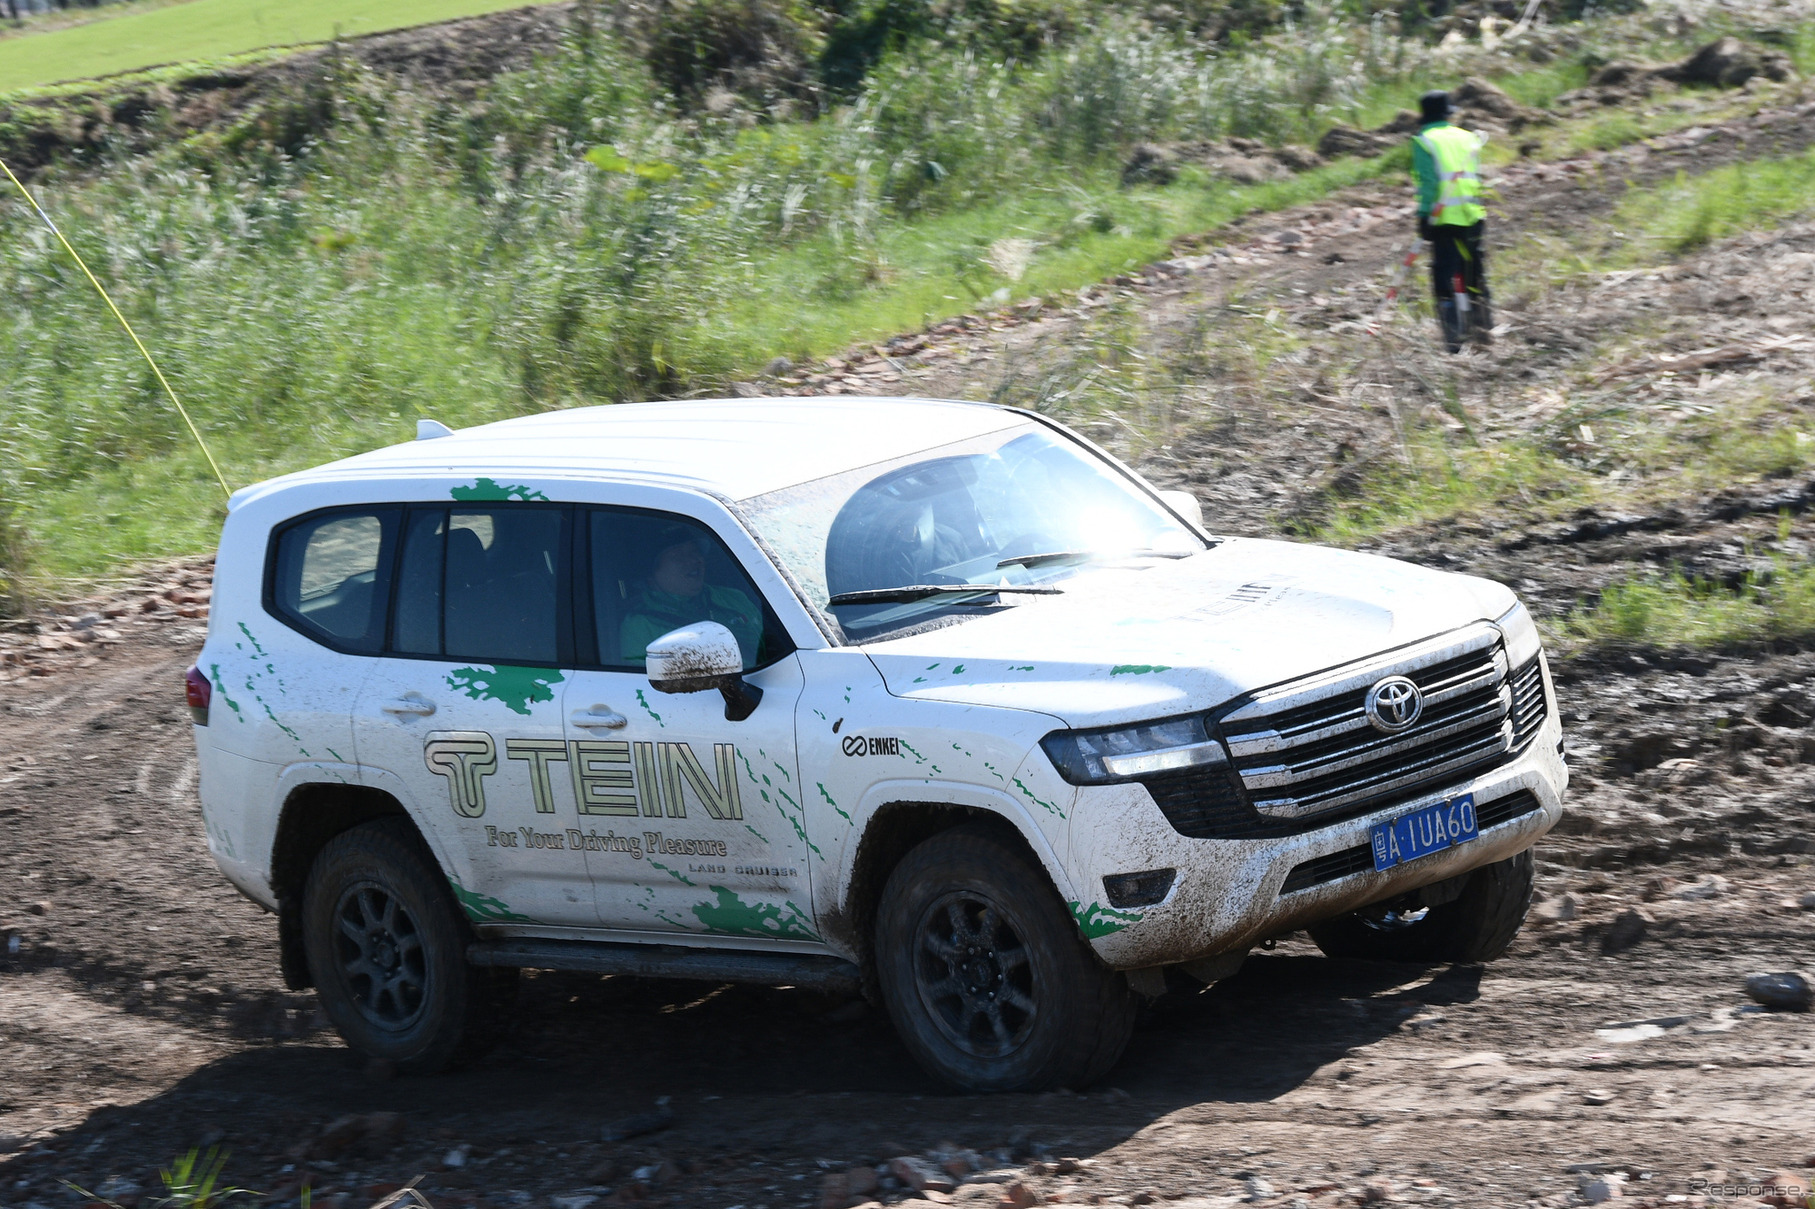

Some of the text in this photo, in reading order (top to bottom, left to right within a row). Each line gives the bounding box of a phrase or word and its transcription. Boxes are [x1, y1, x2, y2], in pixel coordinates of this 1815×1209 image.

[868, 737, 900, 756] ENKEI
[505, 738, 743, 821] TEIN
[484, 825, 728, 860] For Your Driving Pleasure
[688, 863, 726, 874] LAND
